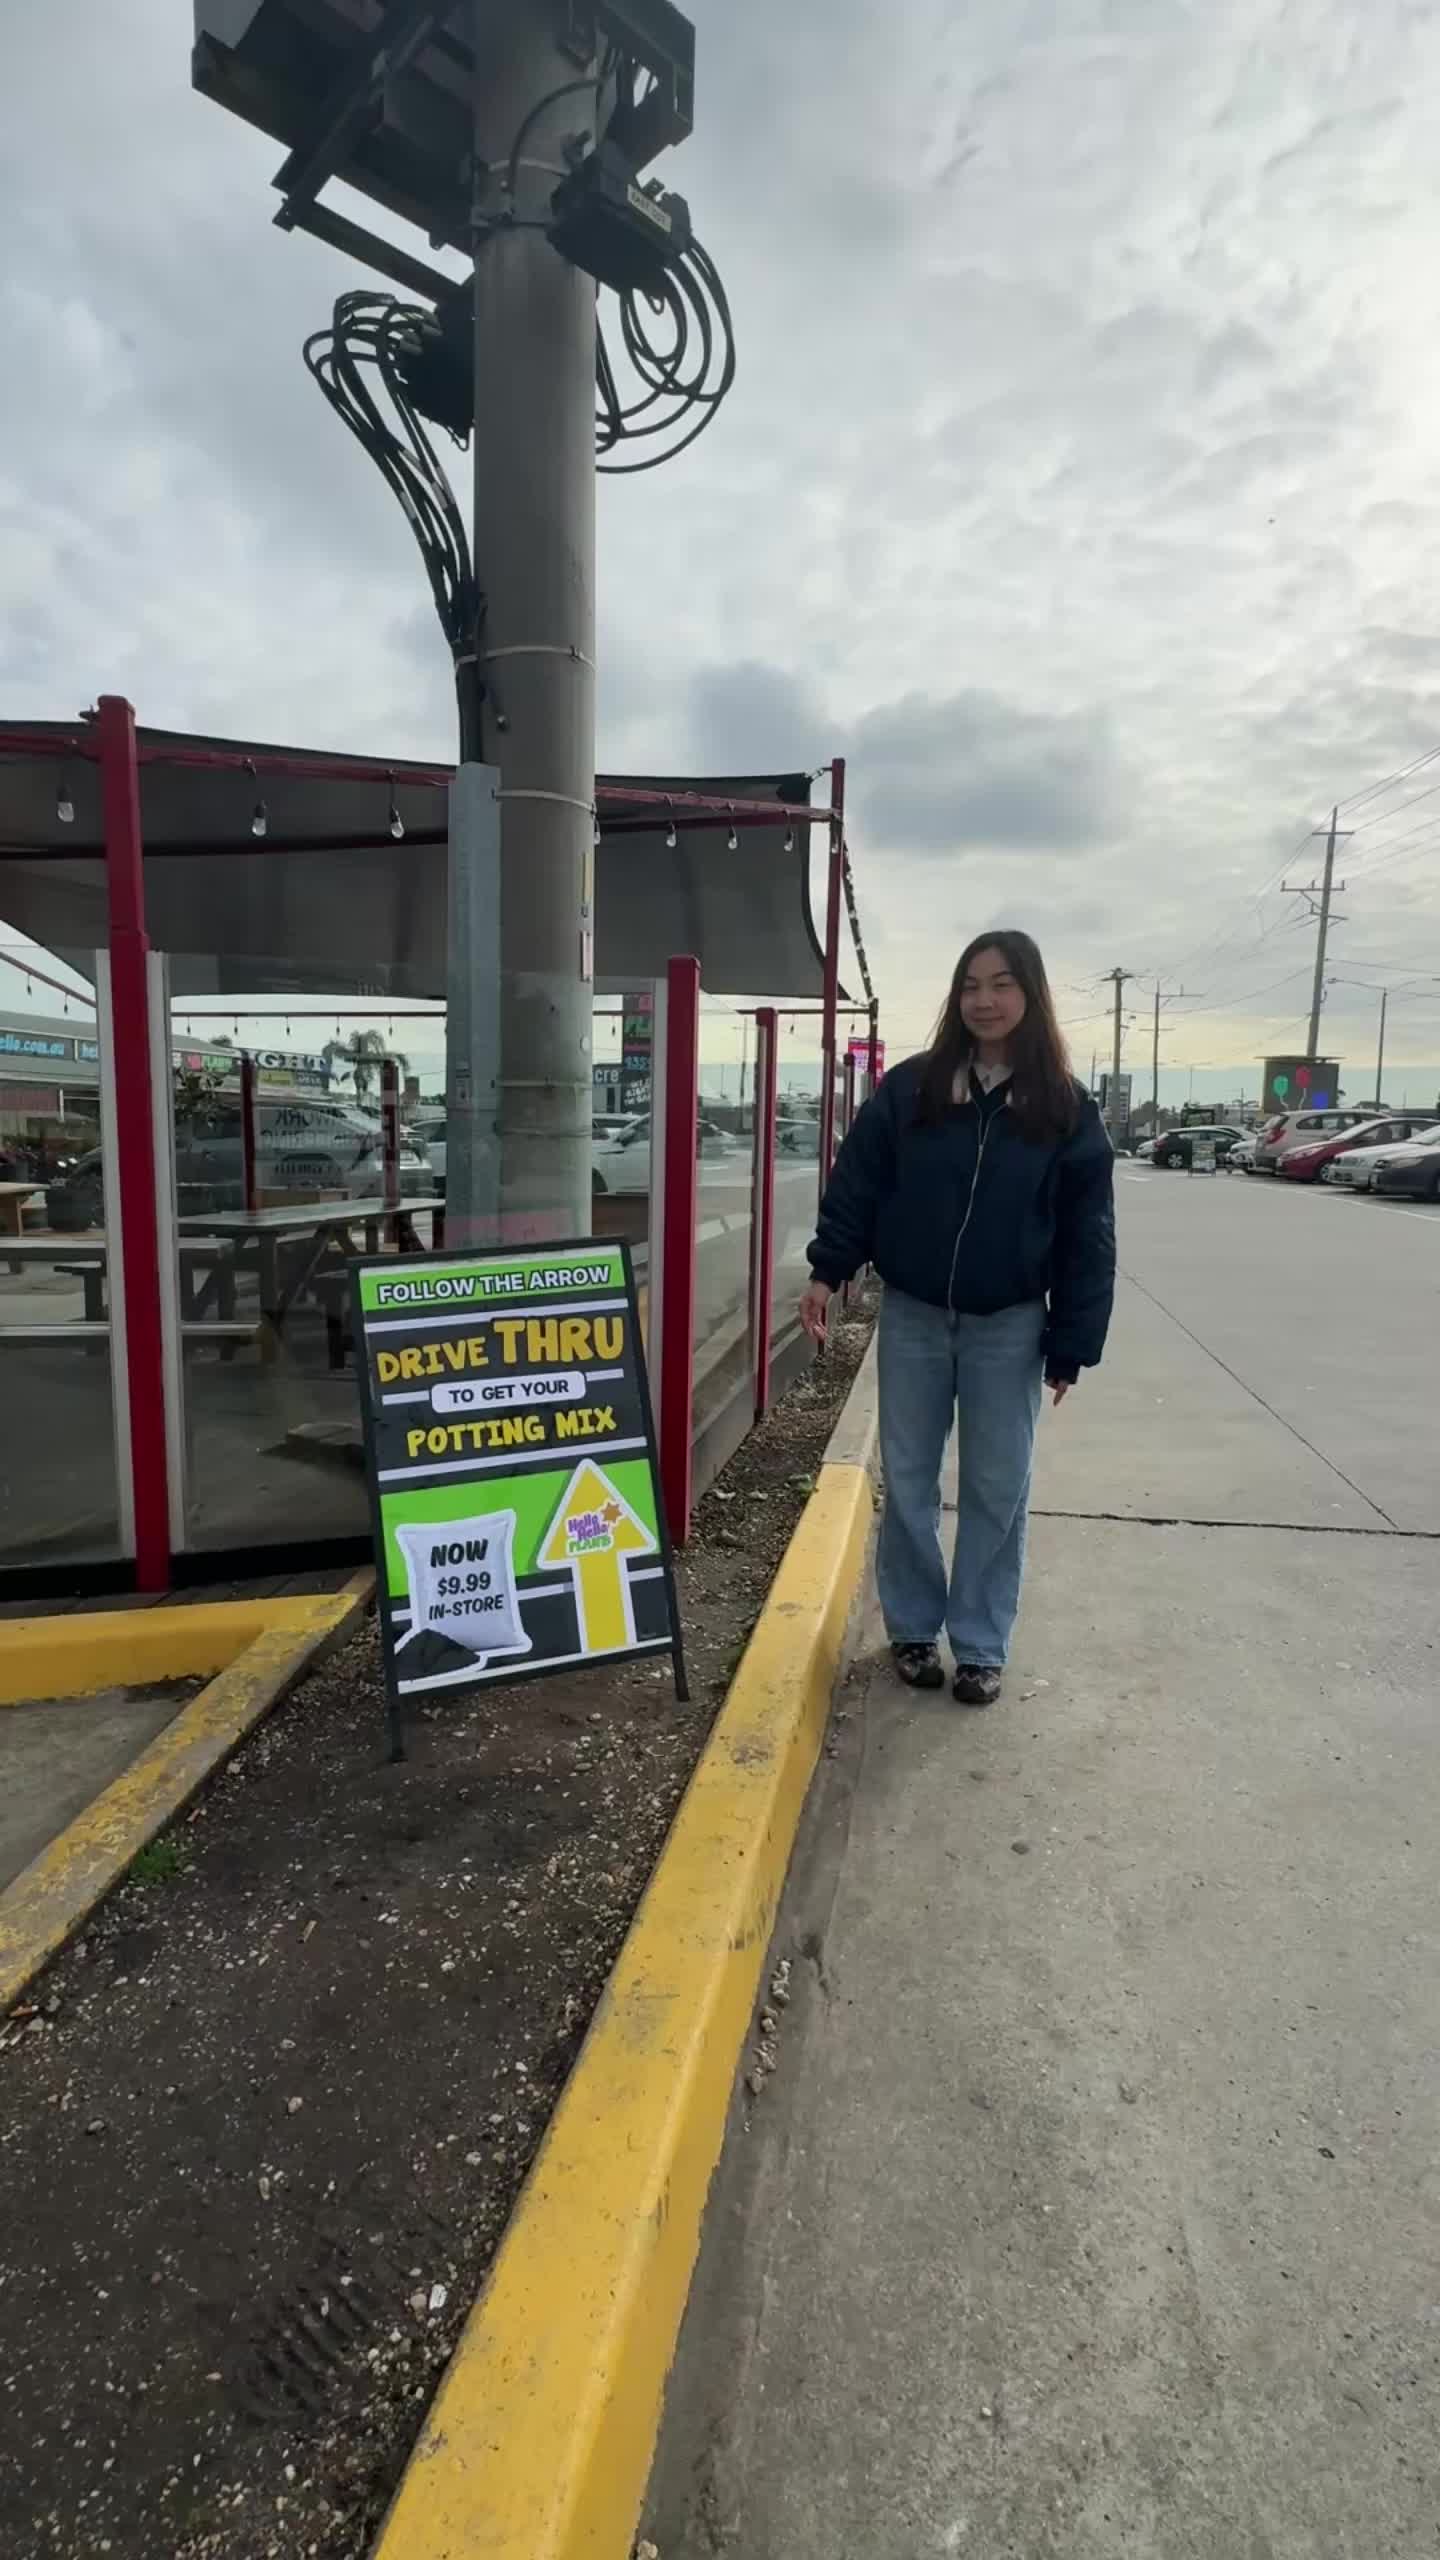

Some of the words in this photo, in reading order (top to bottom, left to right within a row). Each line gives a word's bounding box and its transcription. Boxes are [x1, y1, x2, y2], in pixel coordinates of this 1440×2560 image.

[239, 1050, 326, 1072] IGHT
[378, 1278, 475, 1303] FOLLOW
[479, 1272, 524, 1295] THE
[530, 1265, 610, 1289] ARROW
[376, 1337, 489, 1383] DRIVE
[493, 1316, 624, 1364] THRU
[449, 1389, 474, 1404] TO
[482, 1384, 515, 1401] GET
[521, 1379, 569, 1397] YOUR
[406, 1415, 545, 1457] POTTING
[555, 1406, 616, 1439] MIX
[430, 1539, 488, 1568] NOW
[437, 1571, 491, 1597] $9.99
[429, 1594, 504, 1621] IN-STORE
